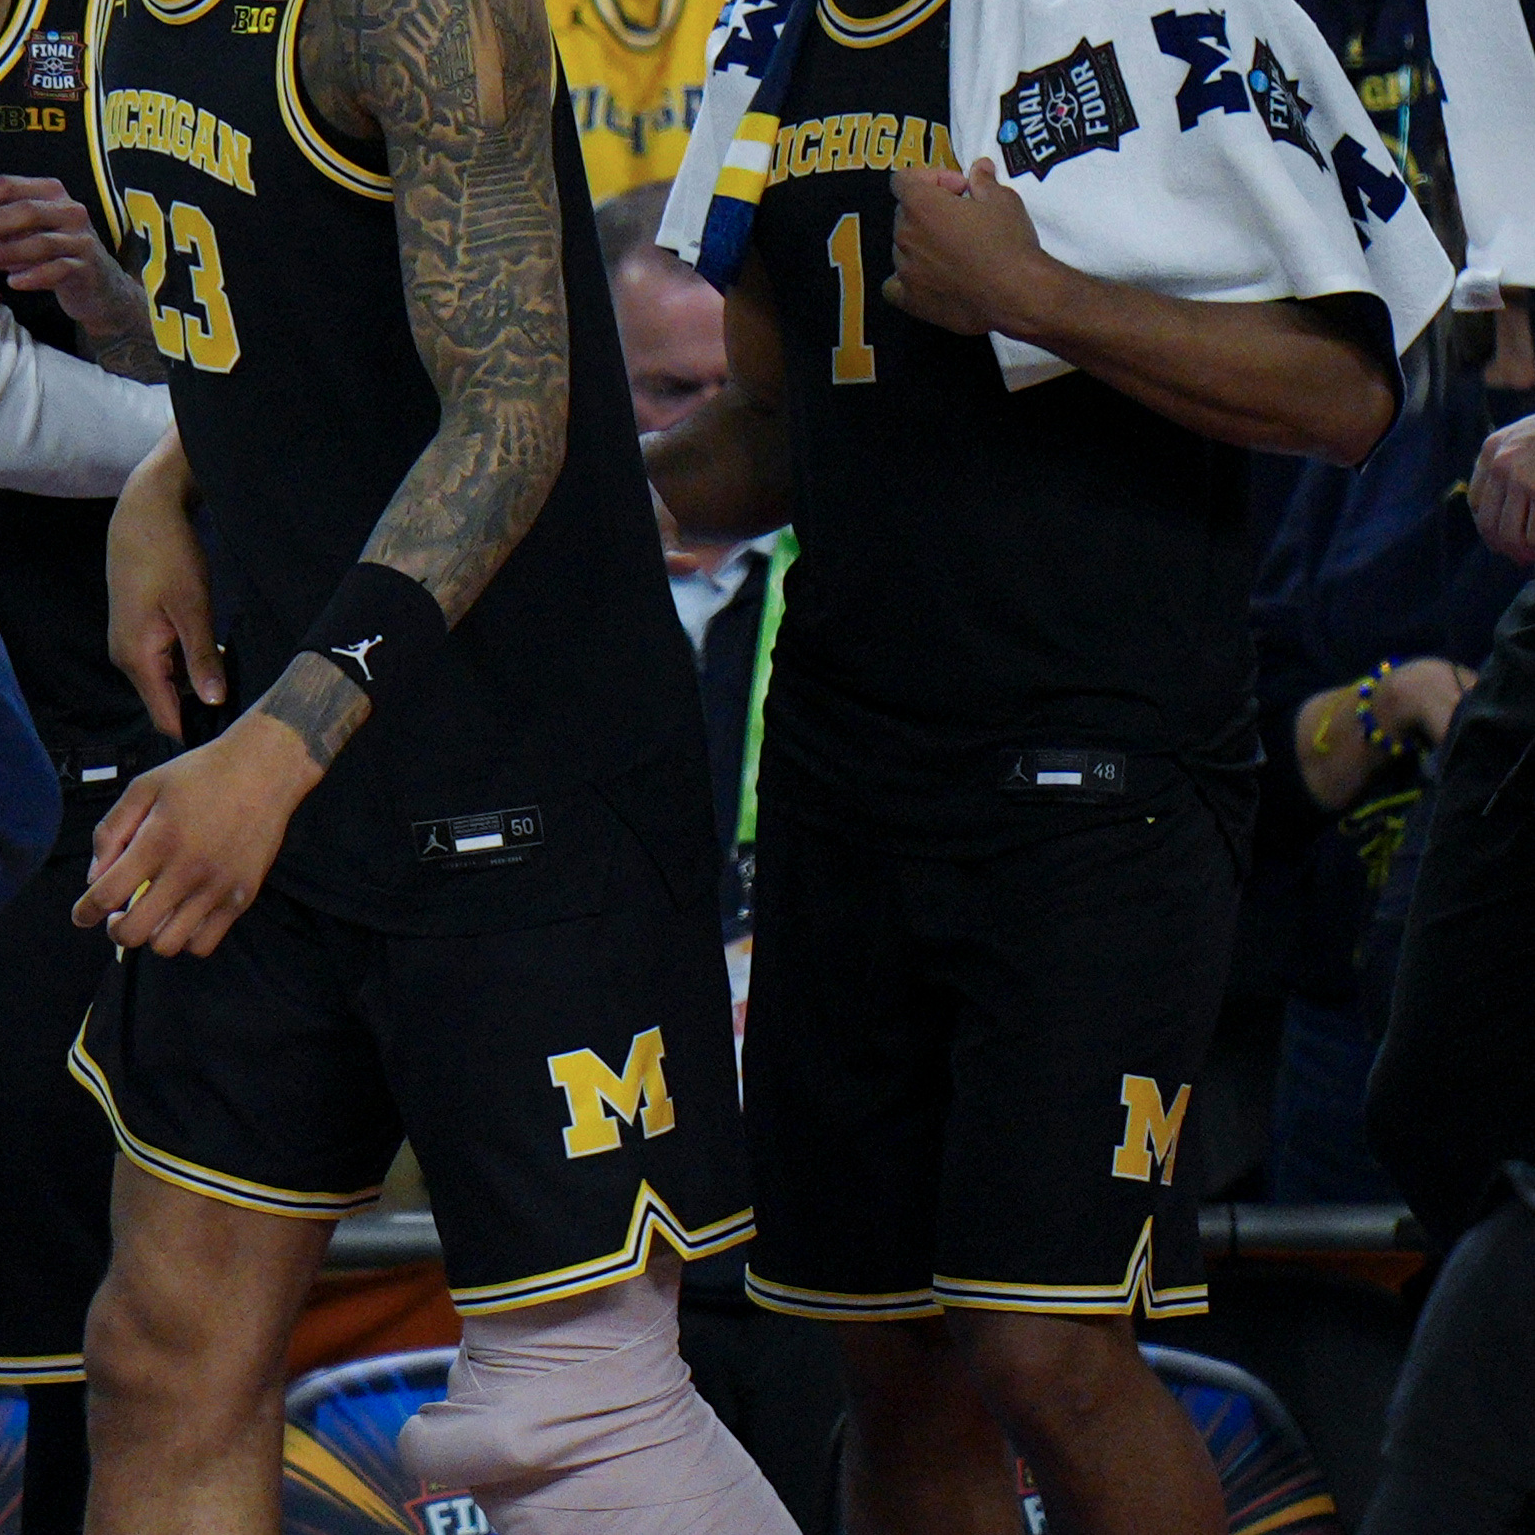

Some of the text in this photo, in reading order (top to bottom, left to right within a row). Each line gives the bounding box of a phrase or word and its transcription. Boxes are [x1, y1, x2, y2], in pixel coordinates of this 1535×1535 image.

[31, 43, 75, 59] FINAL
[32, 73, 76, 90] FOUR
[1017, 82, 1058, 163] FINAL
[1070, 59, 1110, 137] FOUR
[124, 186, 242, 375] 23
[826, 211, 876, 386] 1
[1093, 762, 1116, 780] 48
[510, 816, 535, 837] 50
[546, 1025, 676, 1159] M
[1111, 1073, 1192, 1187] M
